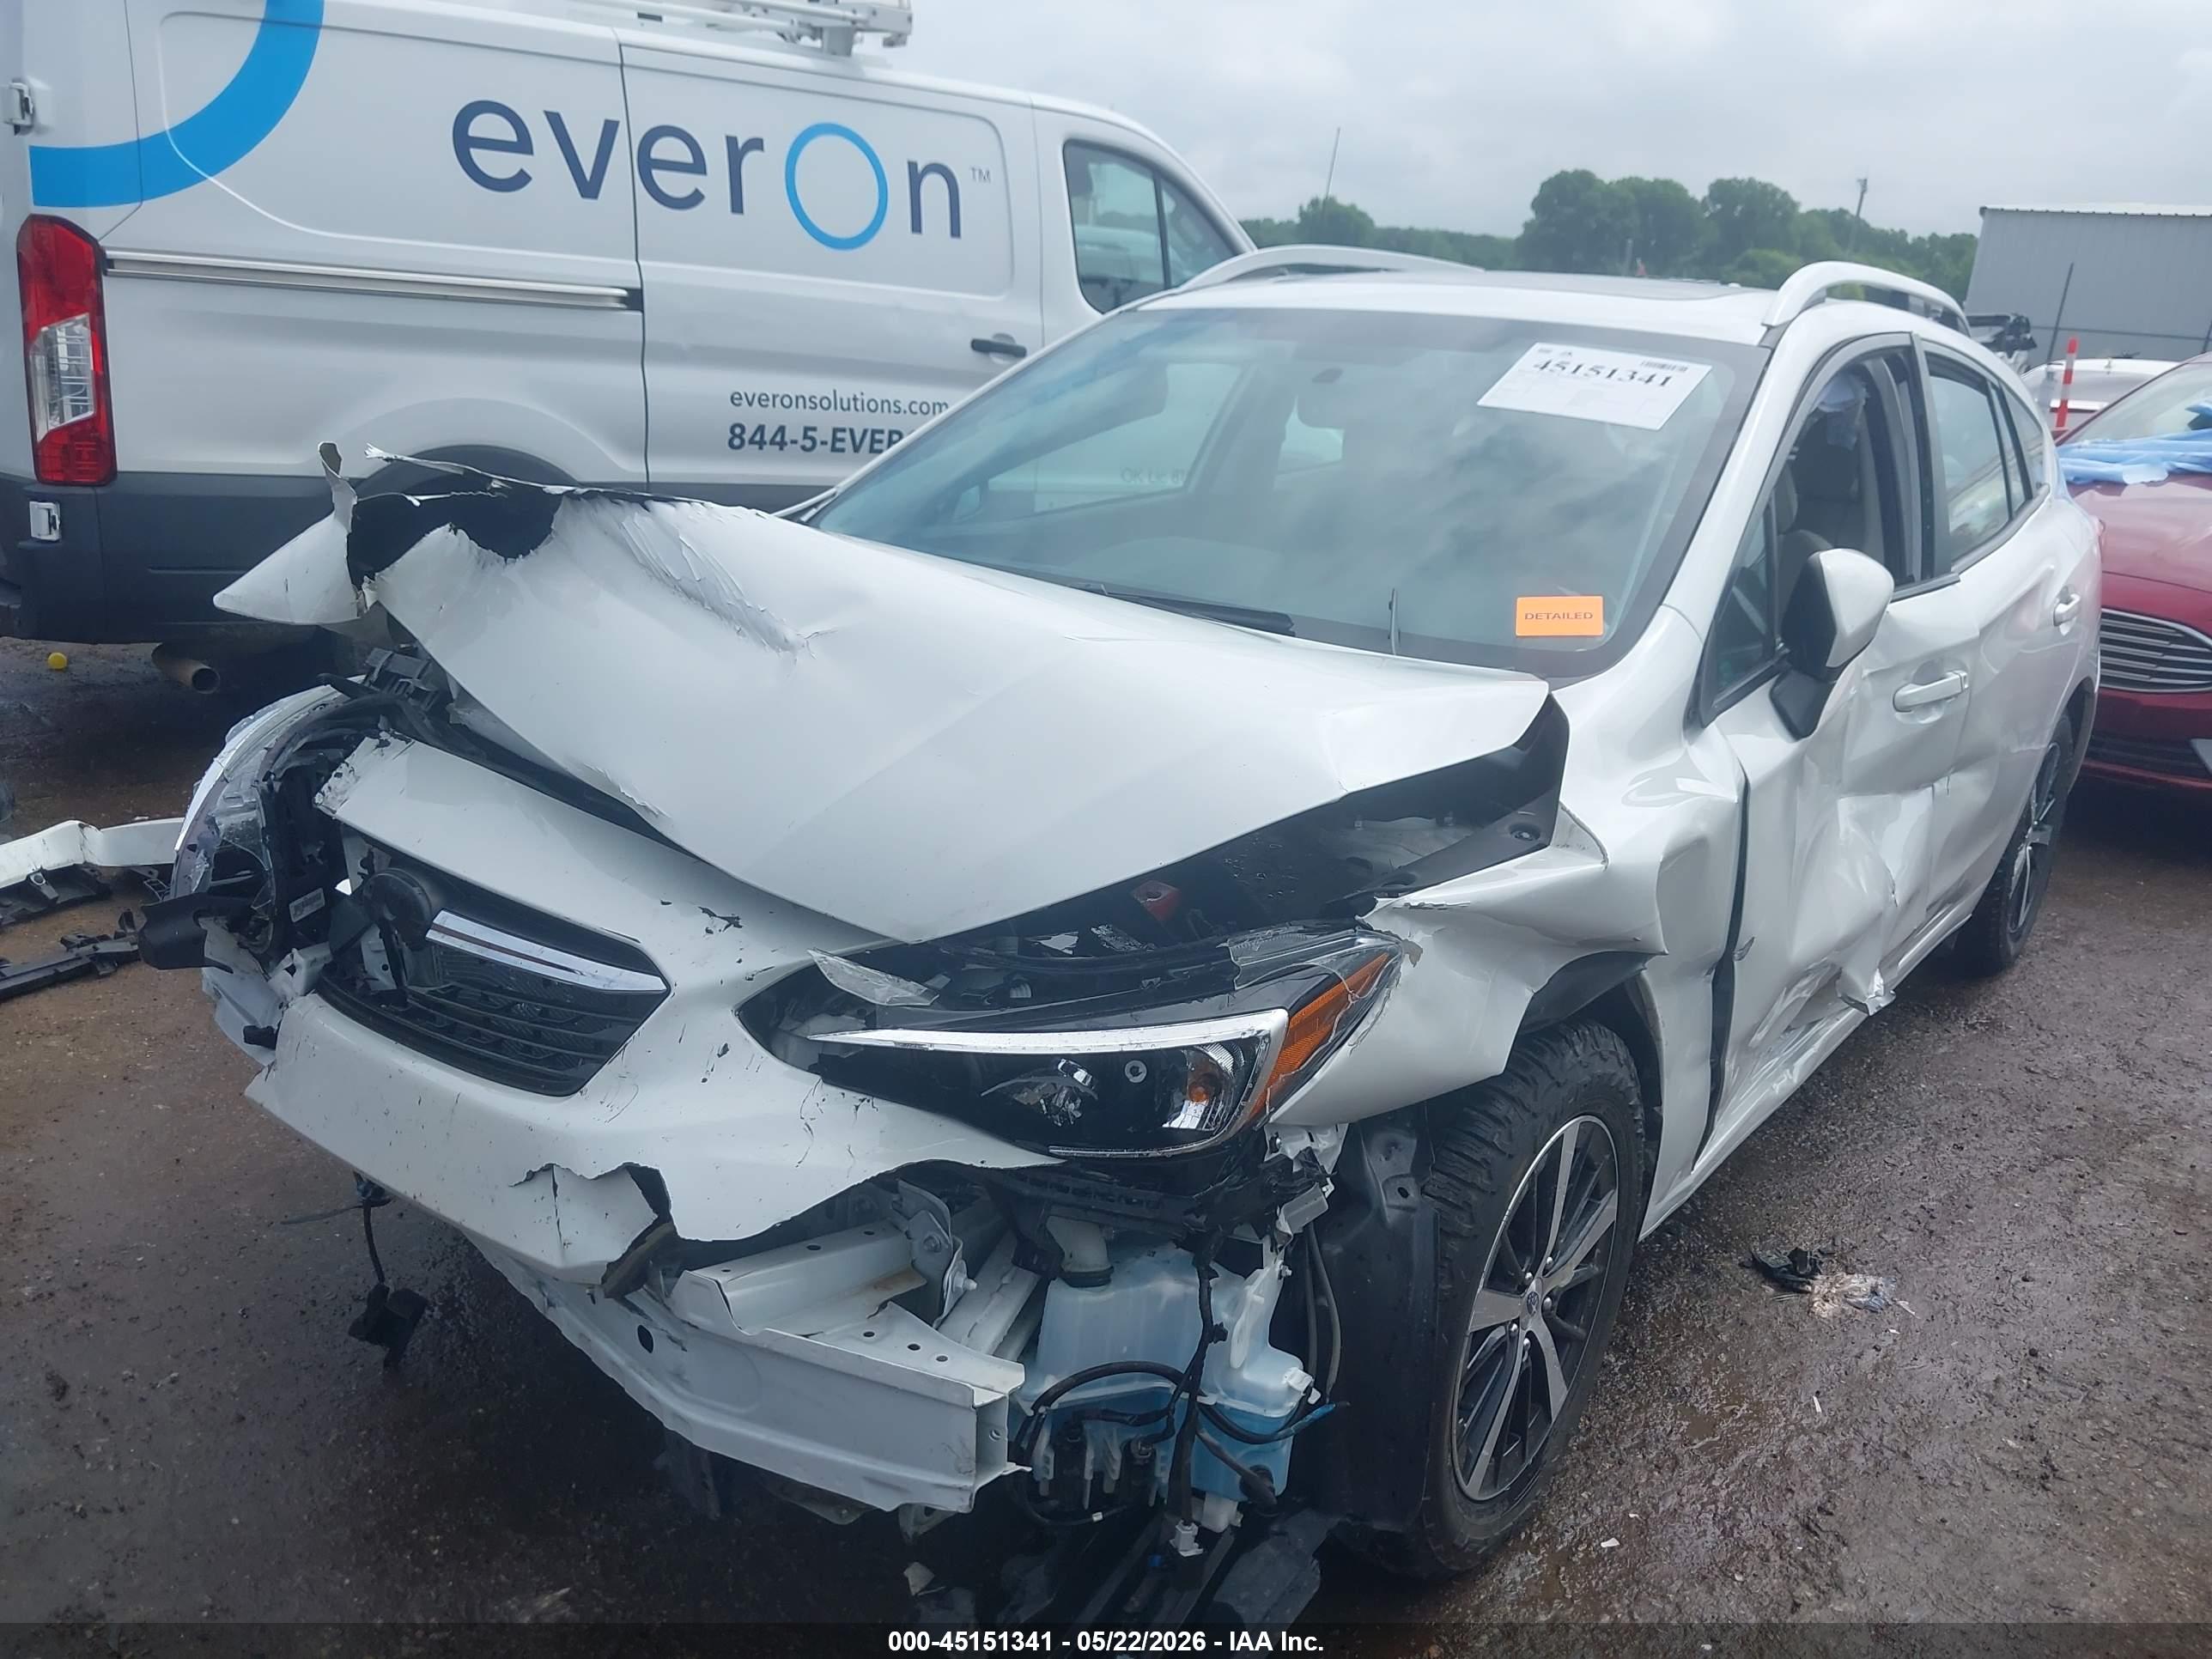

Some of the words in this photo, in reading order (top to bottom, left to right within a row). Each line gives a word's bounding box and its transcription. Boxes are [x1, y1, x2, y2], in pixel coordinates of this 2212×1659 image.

[1533, 359, 1673, 387] 45151341
[729, 389, 950, 416] everonsolutions.com
[1524, 611, 1594, 621] DETAILED
